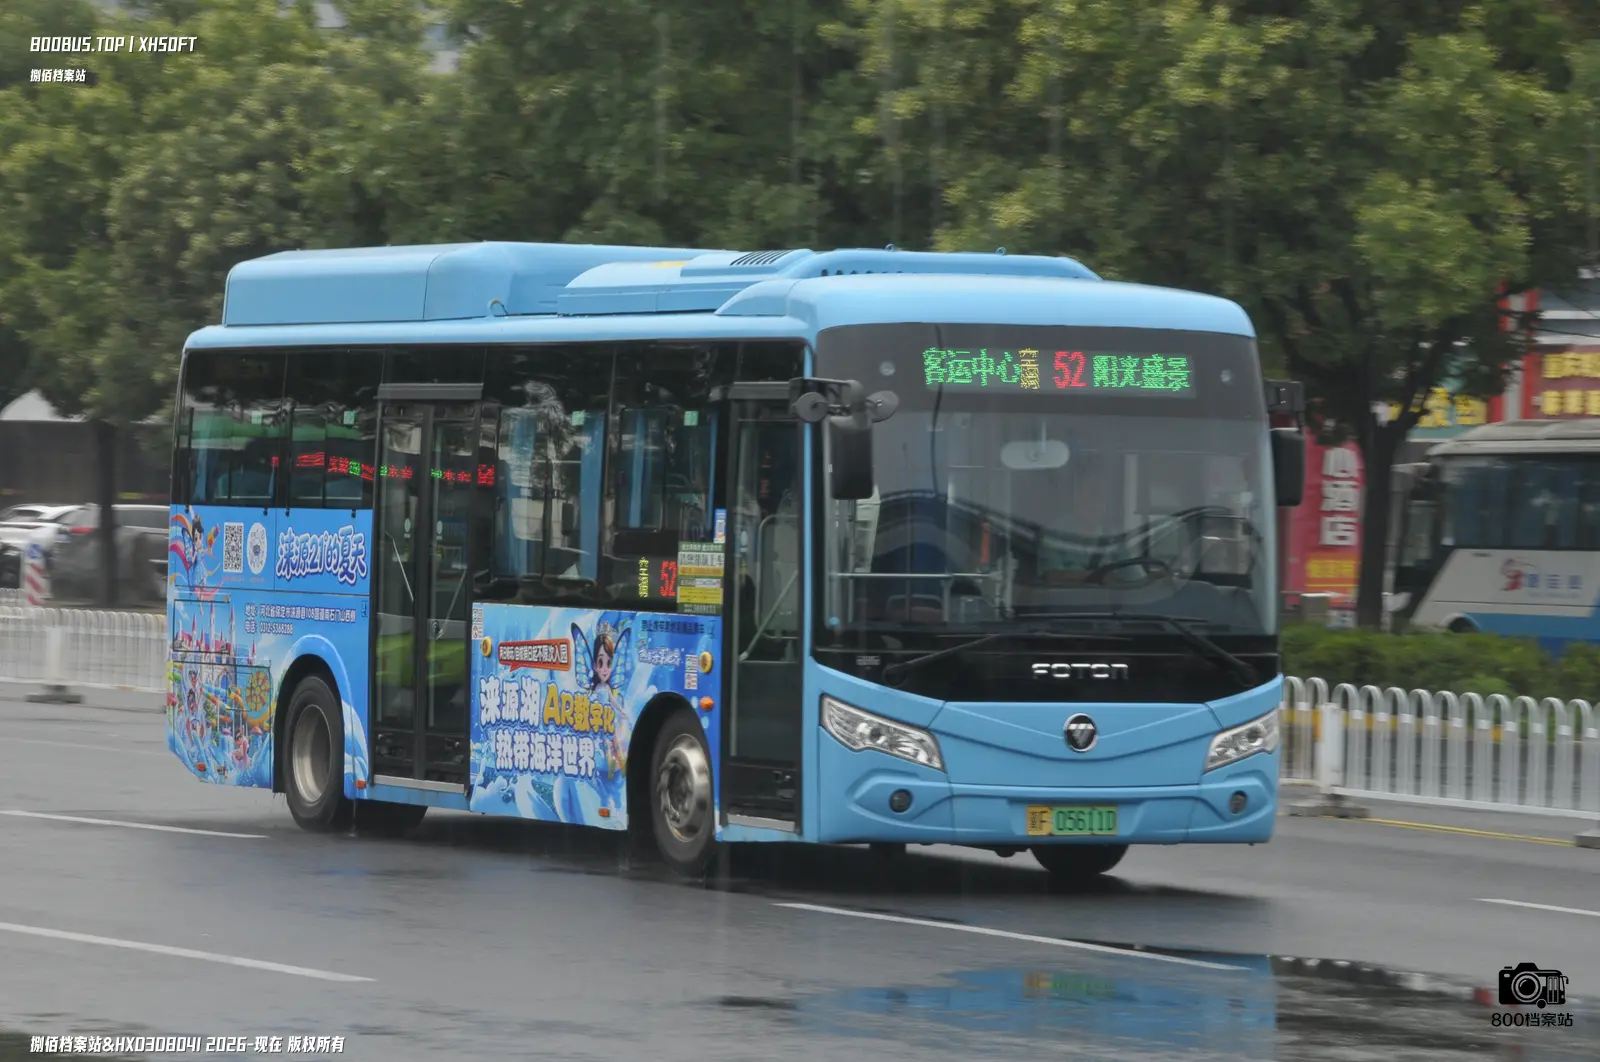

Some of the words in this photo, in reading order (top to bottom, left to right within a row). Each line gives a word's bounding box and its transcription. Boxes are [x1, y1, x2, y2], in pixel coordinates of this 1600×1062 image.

[922, 347, 1020, 386] 客运中心
[1053, 351, 1088, 389] 52
[660, 560, 678, 597] 52
[1031, 663, 1129, 679] FOTON
[480, 674, 540, 727] 涞源湖
[543, 682, 615, 734] AR数字化
[495, 728, 595, 778] 热带海洋世界
[1056, 810, 1117, 832] 05611D
